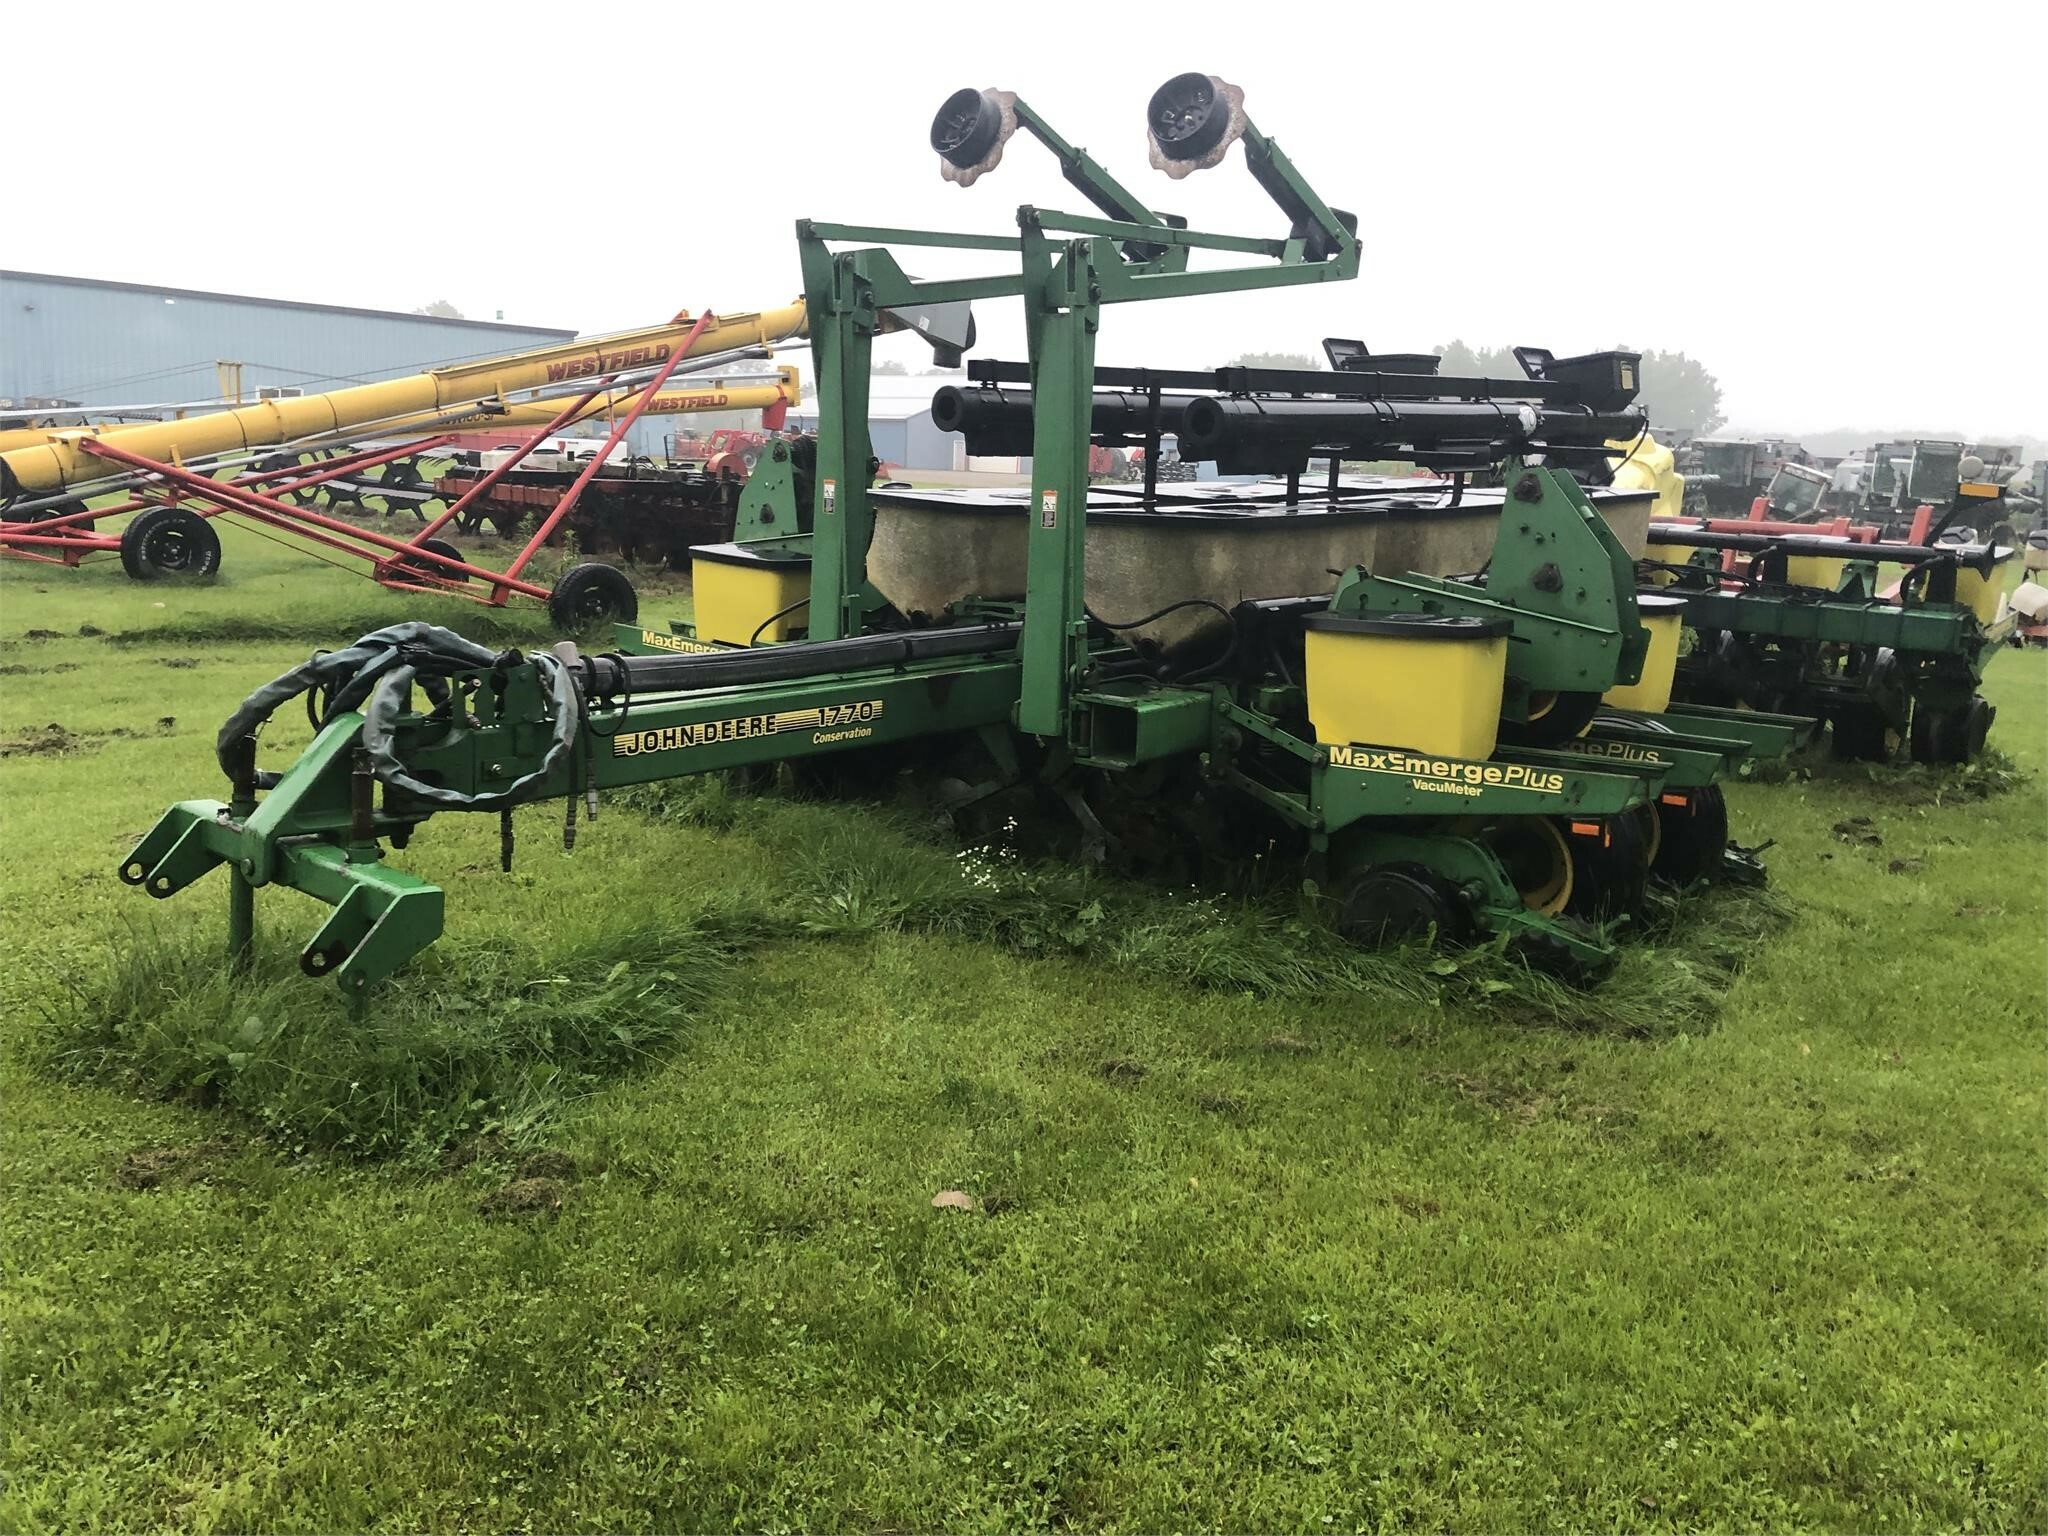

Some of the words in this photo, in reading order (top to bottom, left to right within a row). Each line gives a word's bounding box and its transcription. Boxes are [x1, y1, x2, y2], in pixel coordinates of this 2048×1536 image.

[546, 344, 671, 382] WESTFIELD
[648, 395, 728, 411] WESTFIELD
[642, 630, 724, 654] MaxEmer
[626, 726, 695, 755] JOHN
[701, 715, 777, 744] DEERE
[817, 703, 874, 728] 1770
[812, 726, 872, 745] Conservation
[1329, 746, 1564, 790] MaxEmergePlus
[1412, 778, 1483, 797] VacuMeter
